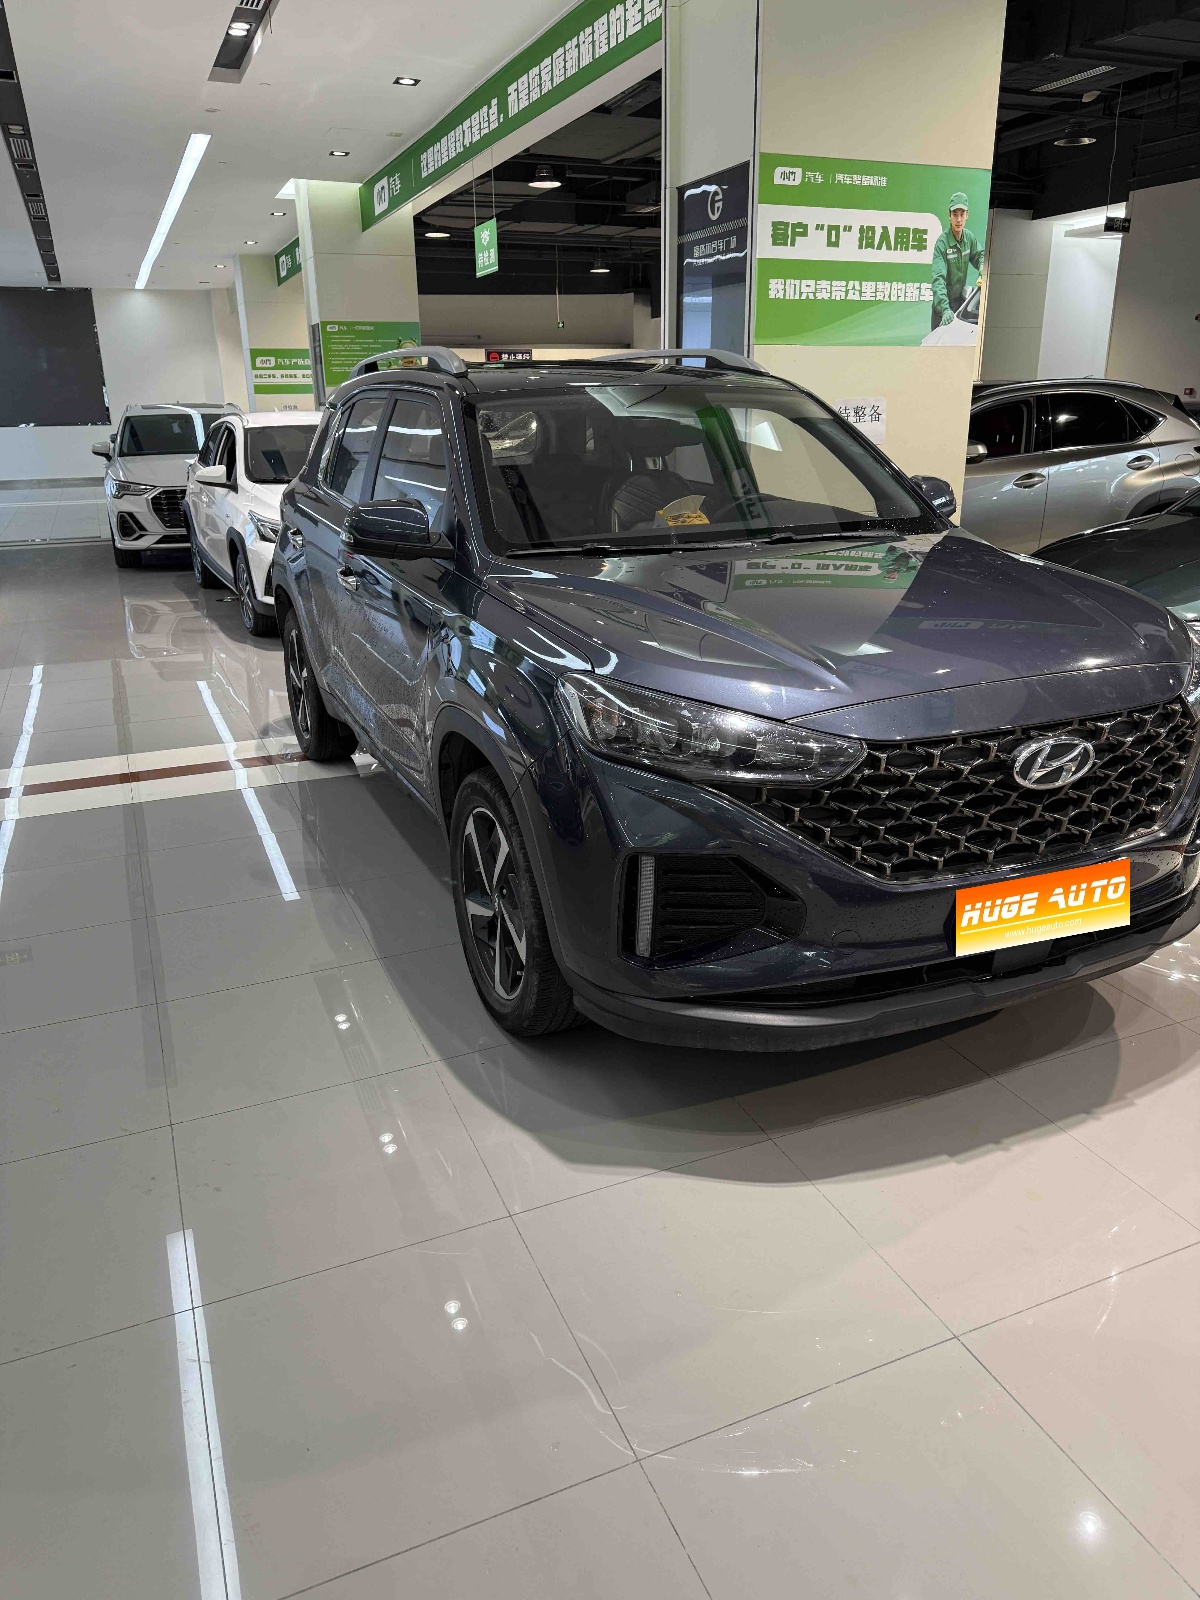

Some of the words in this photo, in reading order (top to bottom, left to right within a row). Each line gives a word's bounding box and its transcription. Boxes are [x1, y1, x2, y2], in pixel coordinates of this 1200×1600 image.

[389, 172, 402, 197] 汽车
[780, 170, 796, 182] 小竹
[805, 171, 824, 184] 汽车
[835, 172, 888, 187] 汽车整备标准
[477, 248, 496, 268] 待检测
[768, 278, 934, 302] 我们只卖带公里数的新车
[838, 404, 882, 424] 待整备
